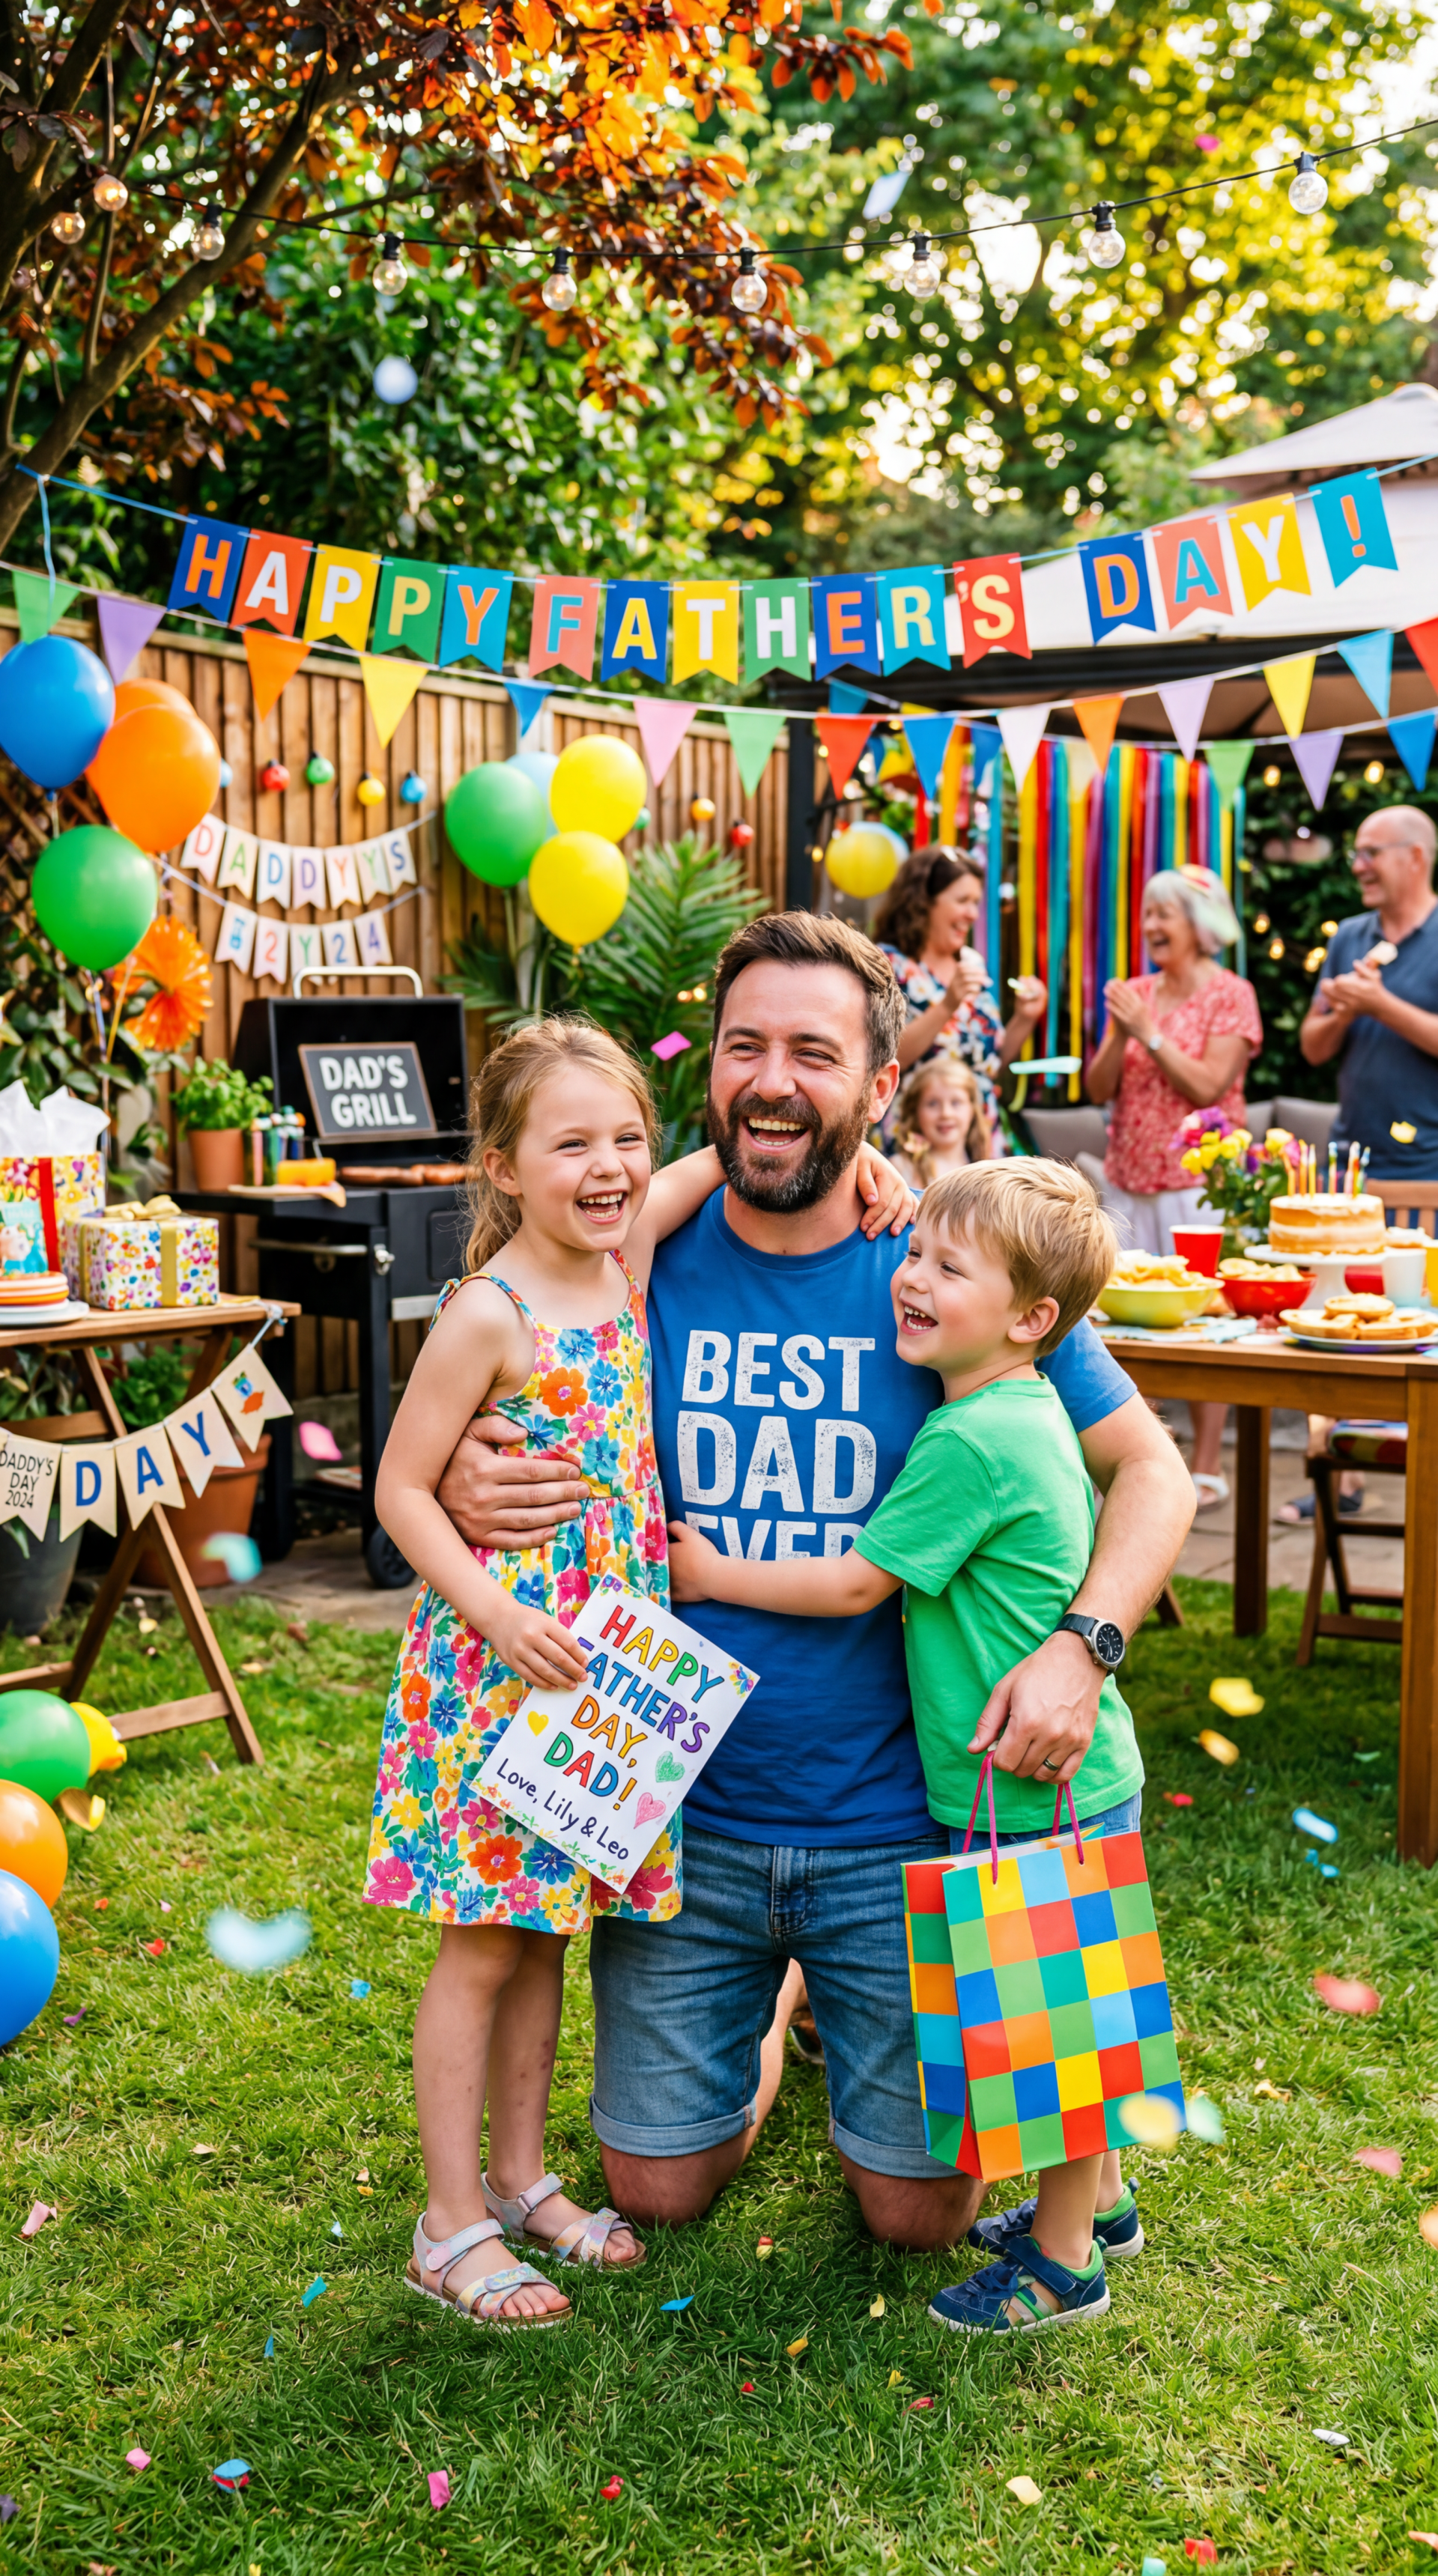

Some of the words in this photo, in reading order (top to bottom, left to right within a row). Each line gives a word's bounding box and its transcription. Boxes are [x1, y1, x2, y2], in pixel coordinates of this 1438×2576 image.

[184, 532, 500, 645] HAPPY
[545, 574, 1016, 660] FATHER'S
[1091, 494, 1367, 619] DAY!
[319, 1055, 408, 1091] DAD'S
[331, 1092, 417, 1128] GRILL
[682, 1329, 876, 1412] BEST
[0, 1450, 54, 1477] DADDY'S
[5, 1489, 34, 1509] 2024
[10, 1471, 39, 1492] DAY
[76, 1411, 211, 1507] DAY
[677, 1410, 877, 1515] DAD
[577, 1636, 711, 1753] ATHER'S
[599, 1605, 725, 1704] HAPPY
[543, 1731, 637, 1811] DAD!
[571, 1694, 648, 1769] DAY,
[497, 1758, 538, 1804] Love,
[544, 1790, 580, 1832] Lily
[580, 1817, 598, 1837] &
[597, 1826, 629, 1860] Leo
